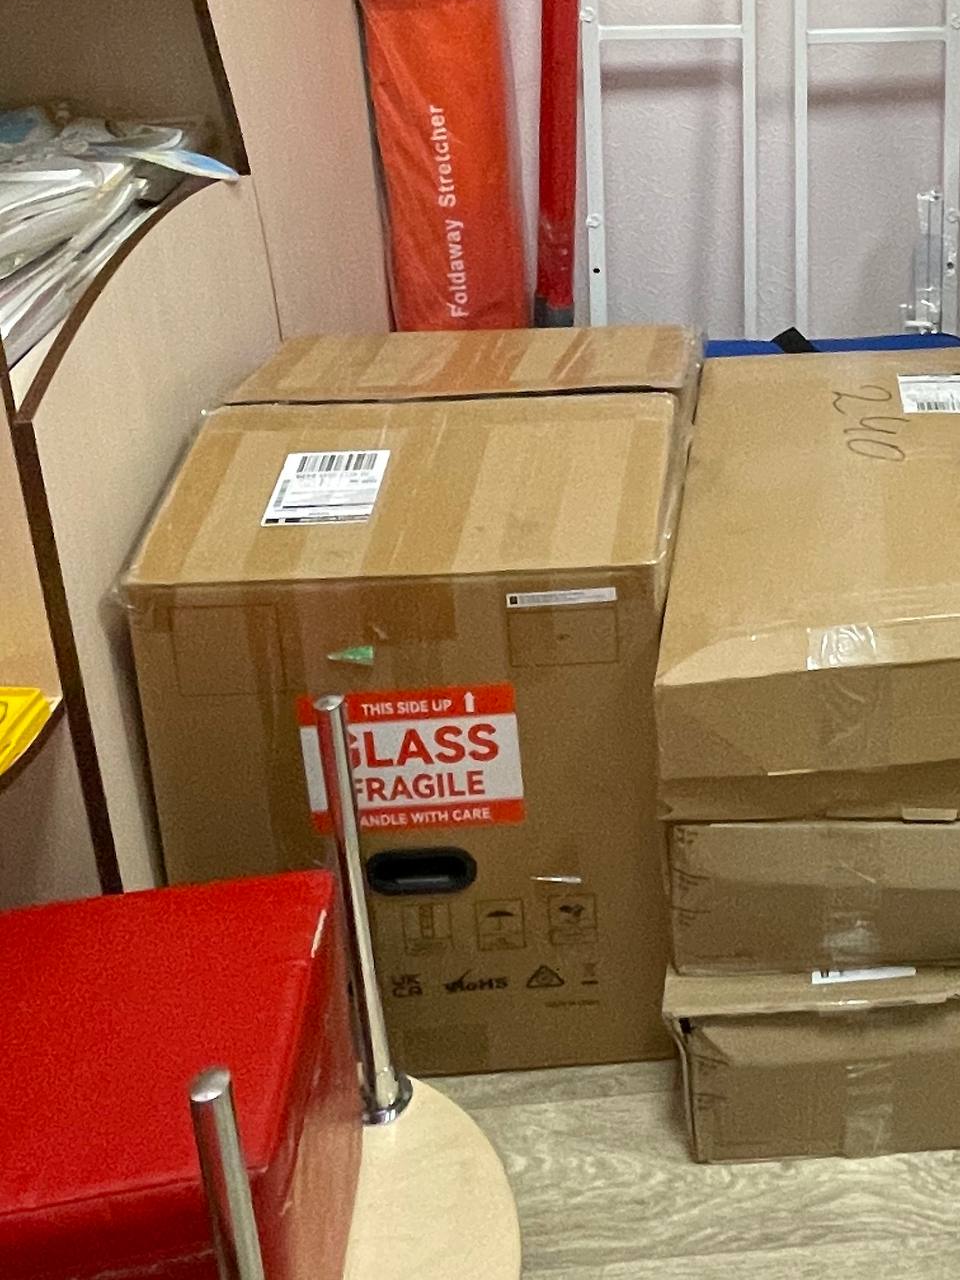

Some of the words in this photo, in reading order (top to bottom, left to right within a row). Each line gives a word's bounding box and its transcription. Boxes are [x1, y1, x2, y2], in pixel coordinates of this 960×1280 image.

[429, 105, 457, 208] Stretcher
[445, 219, 470, 318] Foldaway
[361, 703, 393, 717] THIS
[397, 701, 429, 715] SIDE
[432, 699, 453, 712] UP
[360, 813, 407, 828] ANDLE
[411, 810, 449, 825] WITH
[452, 807, 491, 821] CARE
